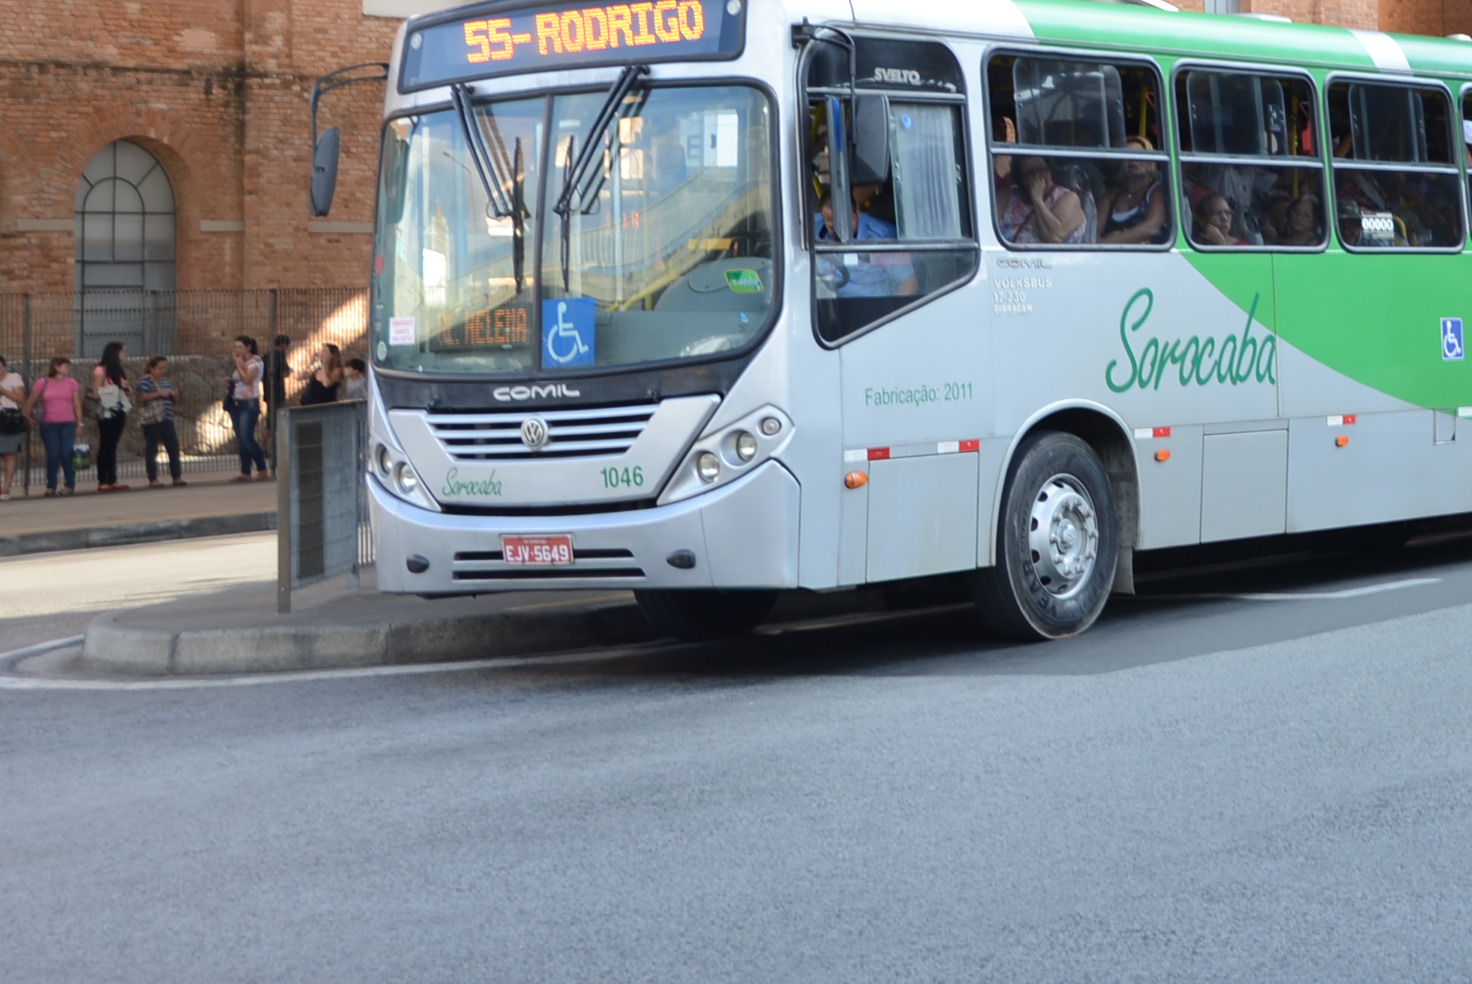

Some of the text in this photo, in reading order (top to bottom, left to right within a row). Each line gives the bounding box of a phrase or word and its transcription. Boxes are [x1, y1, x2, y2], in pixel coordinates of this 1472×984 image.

[463, 0, 705, 64] 55-RODRIGO
[874, 67, 920, 85] SVELTO
[996, 258, 1053, 270] COMIL
[993, 277, 1054, 289] VOLKSBUS
[1105, 287, 1277, 393] Sorocaba
[493, 384, 581, 402] COMIL
[864, 382, 974, 407] Fabricação: 2011
[441, 467, 502, 496] Sorocaba
[600, 465, 644, 488] 1046
